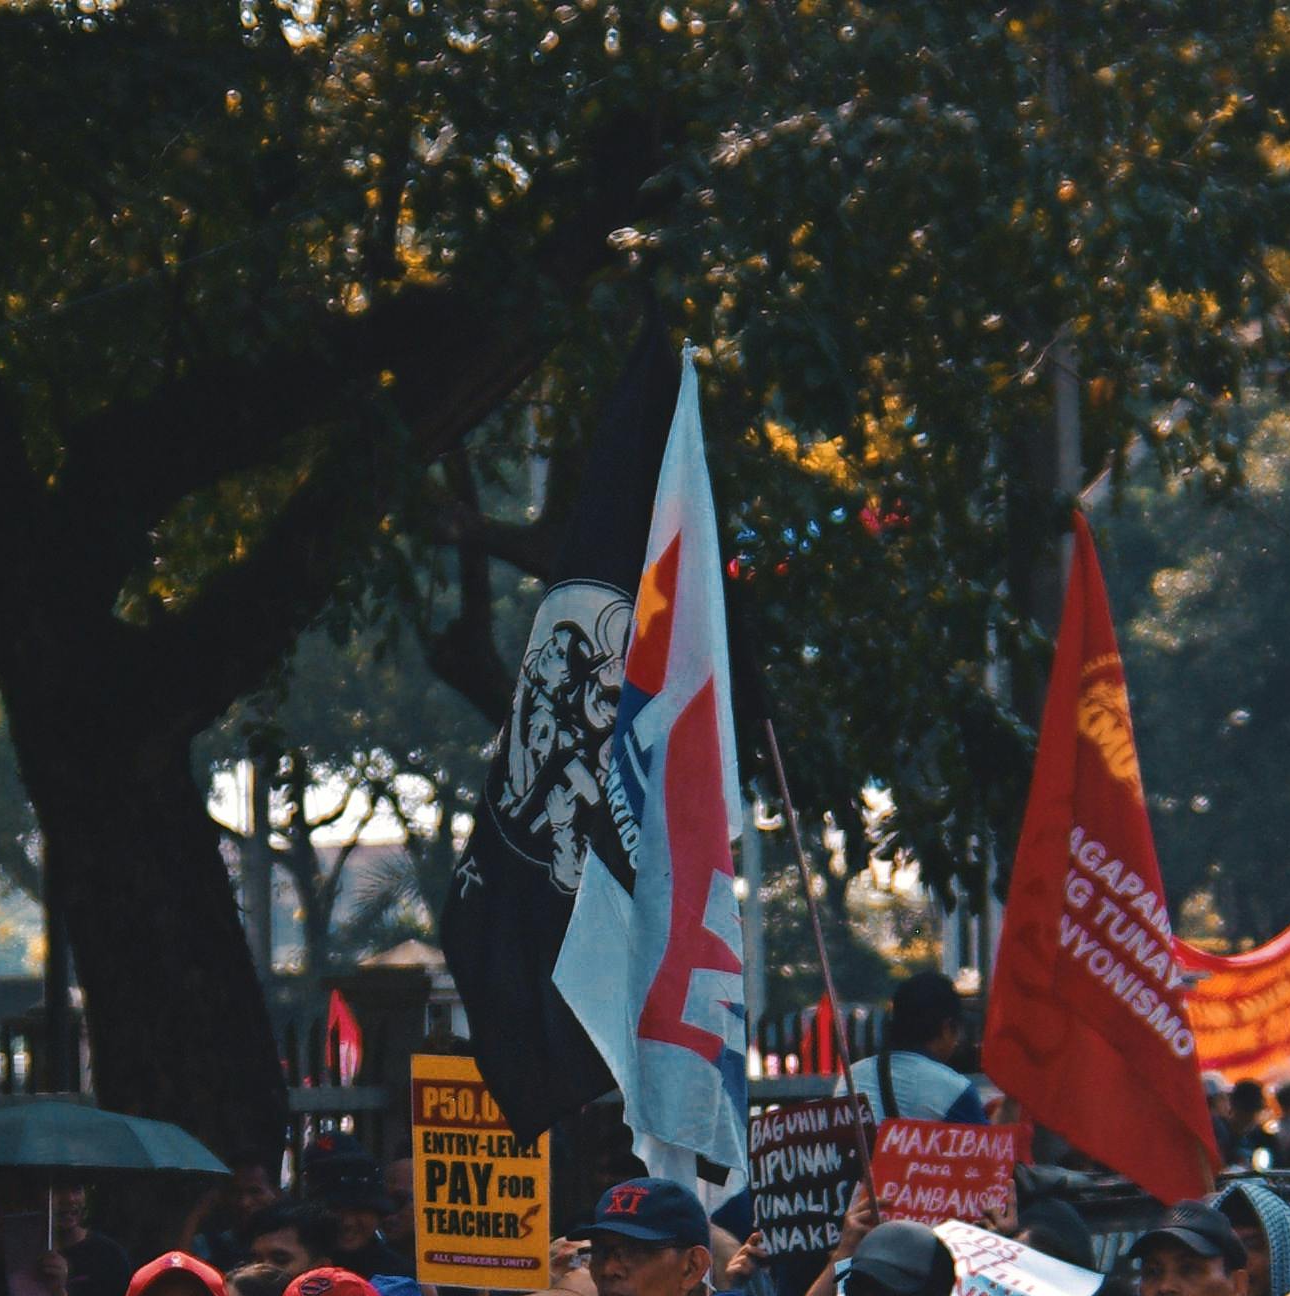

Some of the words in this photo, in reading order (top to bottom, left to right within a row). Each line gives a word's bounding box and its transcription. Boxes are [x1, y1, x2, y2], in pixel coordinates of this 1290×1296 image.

[422, 1085, 506, 1124] P50,0
[425, 1159, 494, 1206] PAY
[498, 1175, 535, 1199] FOR
[907, 1161, 952, 1179] para
[424, 1204, 541, 1239] TEACHERS
[433, 1252, 450, 1264] ALL
[452, 1254, 499, 1267] WORKERS
[502, 1256, 533, 1268] UNITY
